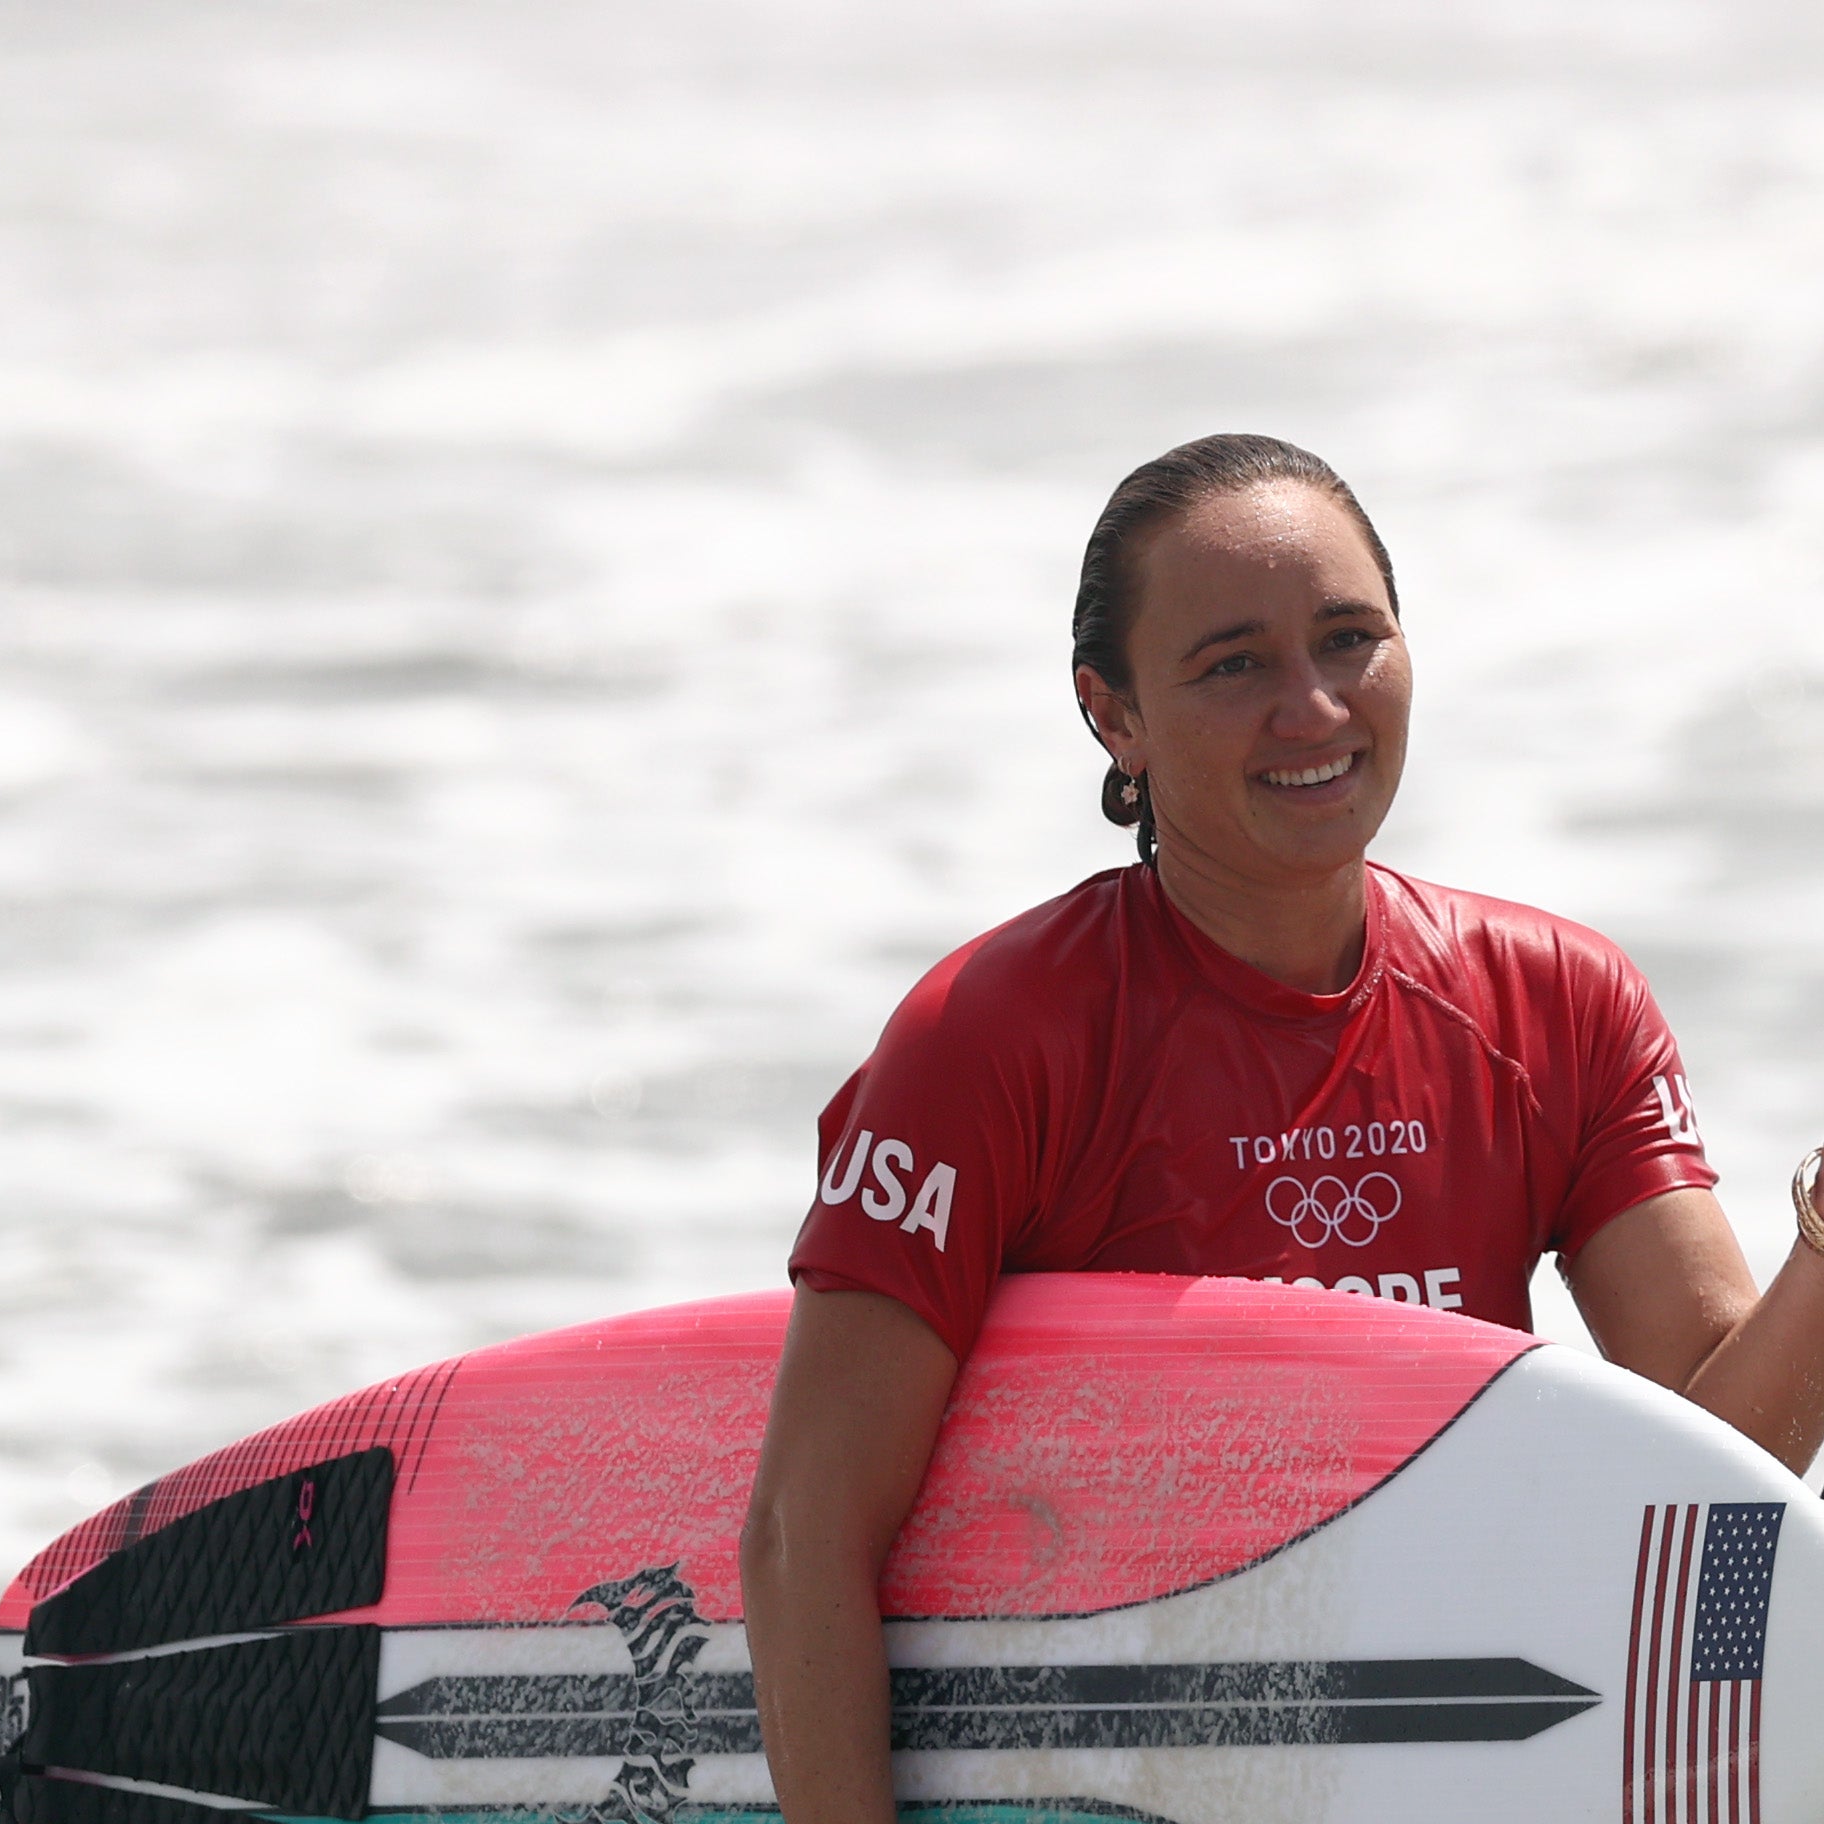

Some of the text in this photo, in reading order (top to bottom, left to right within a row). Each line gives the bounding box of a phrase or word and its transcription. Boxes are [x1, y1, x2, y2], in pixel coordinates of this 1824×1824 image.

[1228, 1119, 1427, 1170] TOKYO 2020
[820, 1128, 958, 1253] USA
